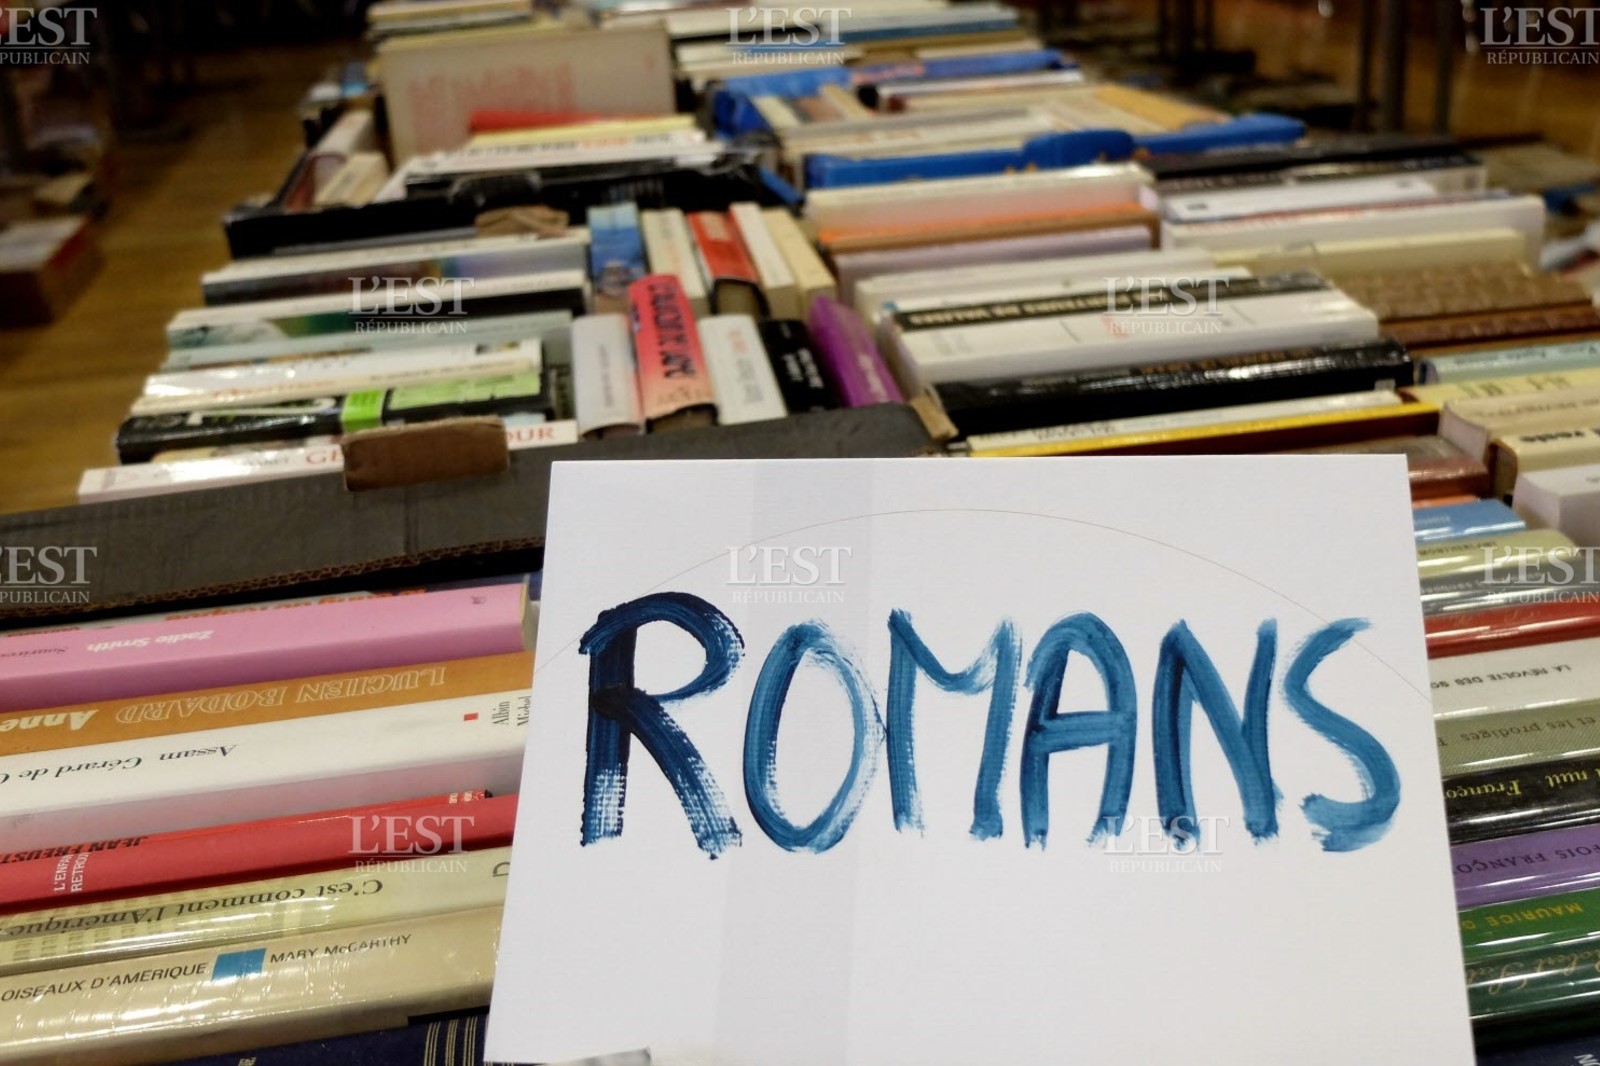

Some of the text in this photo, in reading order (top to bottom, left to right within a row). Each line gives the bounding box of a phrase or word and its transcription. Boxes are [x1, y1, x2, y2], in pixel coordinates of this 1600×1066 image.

[86, 636, 150, 654] Smith
[155, 628, 214, 649] Zadie
[296, 667, 446, 705] LUCIEN
[115, 684, 287, 724] BODARD
[491, 700, 510, 725] Albin
[578, 590, 1402, 859] ROMANS
[1460, 721, 1542, 744] prodiges
[1546, 718, 1572, 731] les
[1575, 716, 1597, 728] et
[159, 744, 238, 763] Assam
[18, 767, 48, 782] de
[55, 755, 142, 779] Gérard
[1545, 770, 1588, 790] nuit
[88, 835, 149, 853] JEAN
[1453, 851, 1546, 876] FRANÇO
[10, 877, 384, 939] C'est comment l'Amérique
[1485, 902, 1584, 928] MAURICE
[1, 934, 413, 1002] OISEAUX D'AMERIQUE MARY McCARTHY
